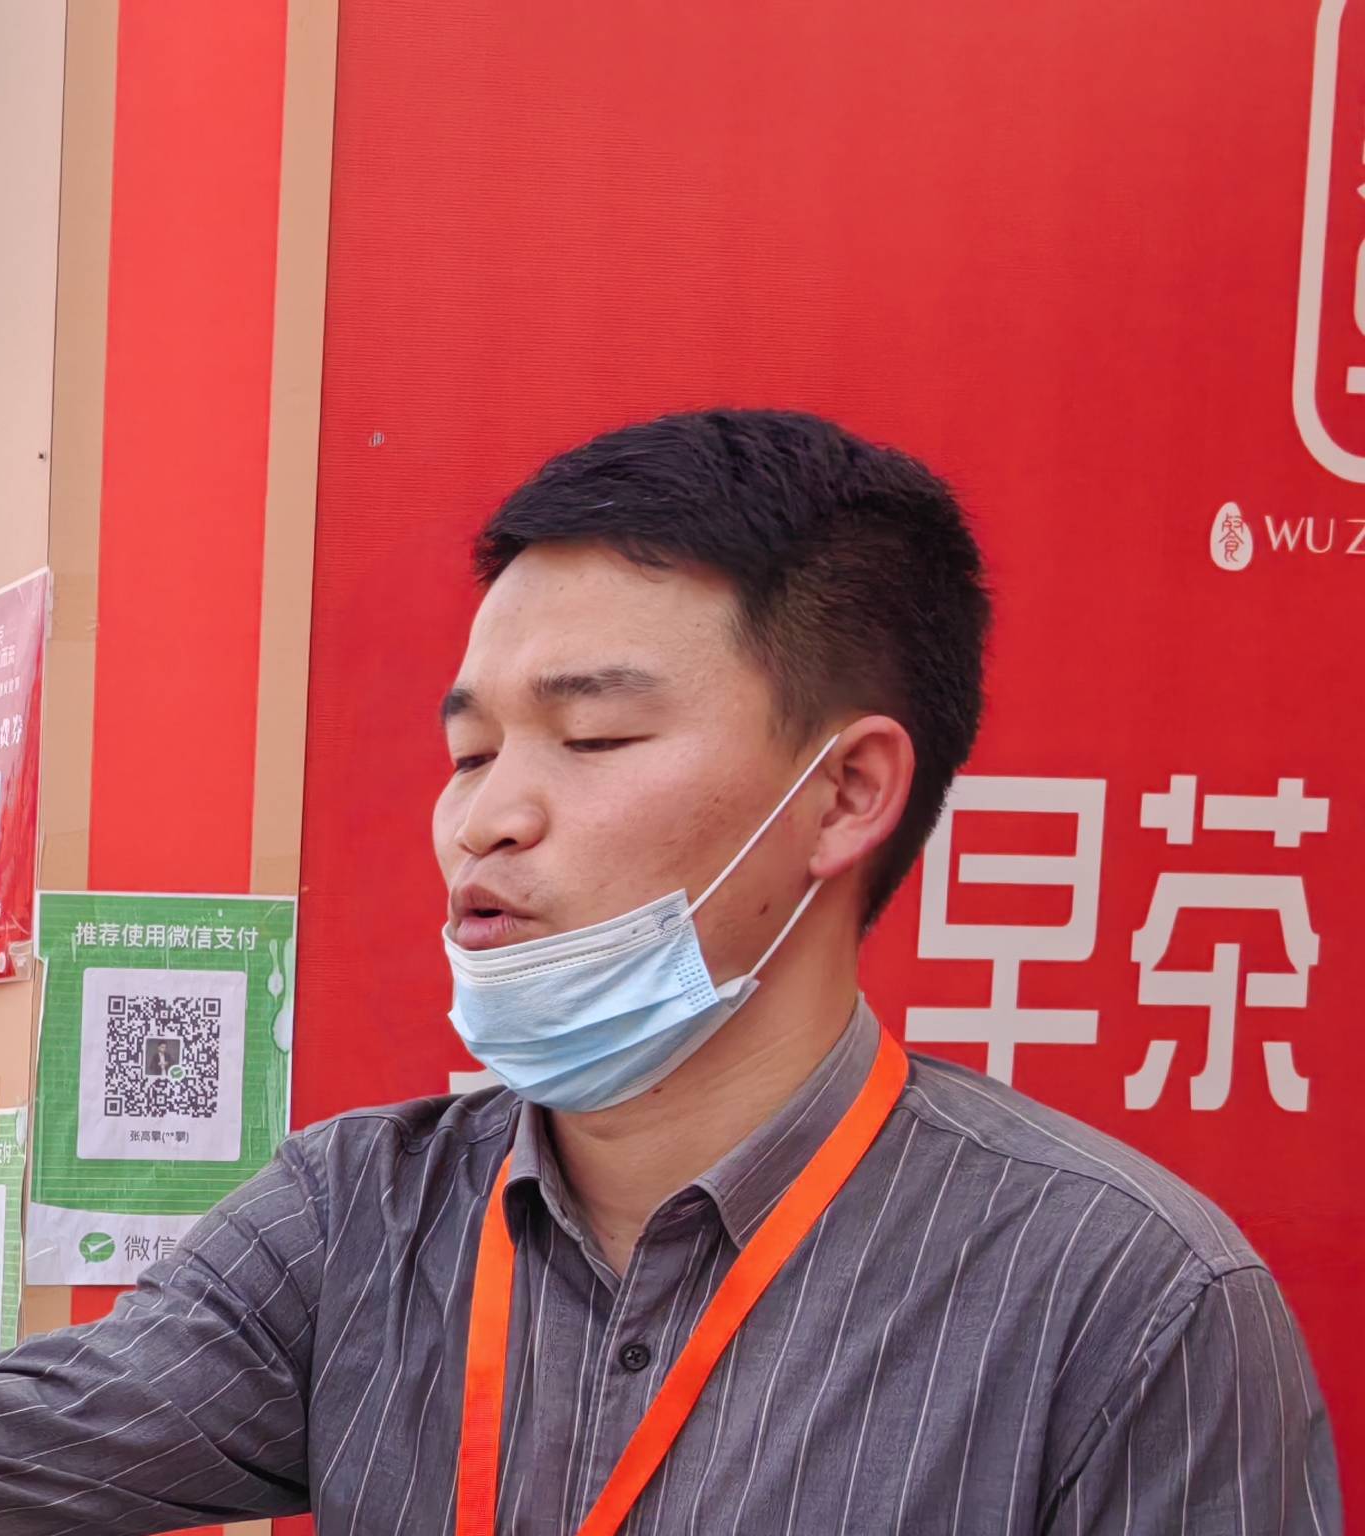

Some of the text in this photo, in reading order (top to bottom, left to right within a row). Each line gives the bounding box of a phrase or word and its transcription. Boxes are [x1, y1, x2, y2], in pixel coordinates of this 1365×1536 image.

[75, 922, 259, 950] 推荐使用微信支付
